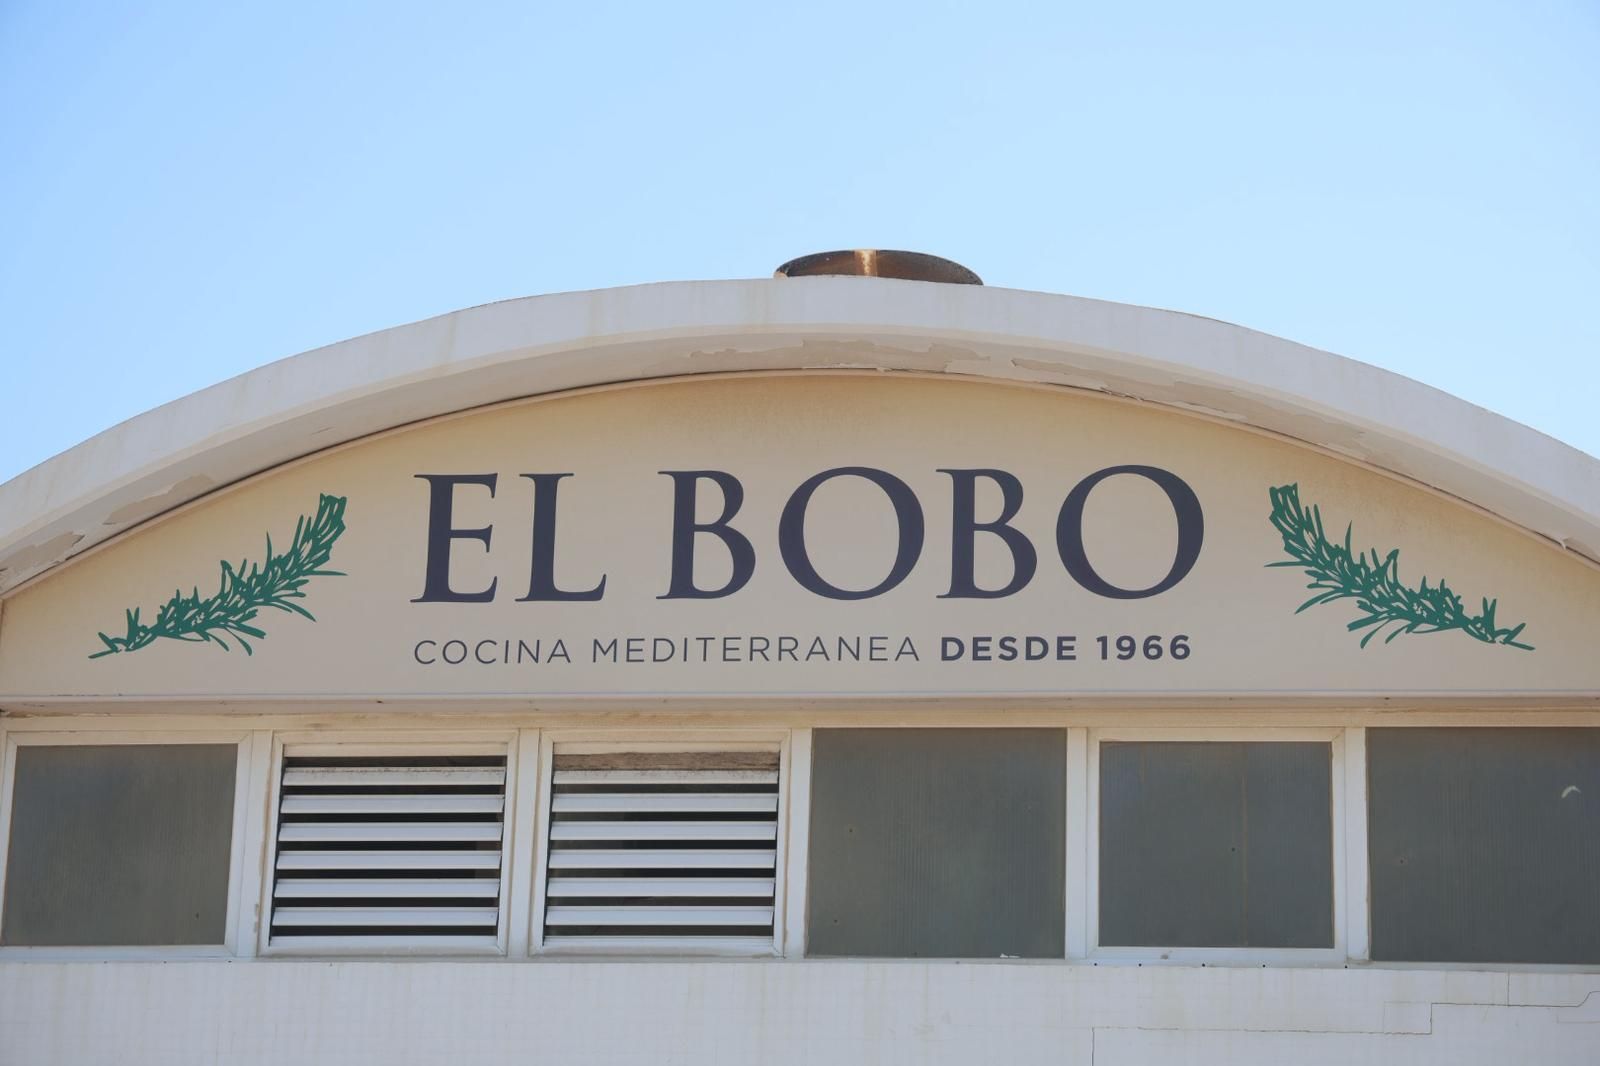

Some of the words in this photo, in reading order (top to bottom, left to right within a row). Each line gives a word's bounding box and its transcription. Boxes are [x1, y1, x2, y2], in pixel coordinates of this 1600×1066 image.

[410, 472, 607, 603] EL
[656, 464, 1205, 601] BOBO
[414, 638, 572, 665] COCINA
[592, 635, 920, 664] MEDITERRANEA
[940, 635, 1077, 662] DESDE
[1095, 634, 1191, 661] 1966
